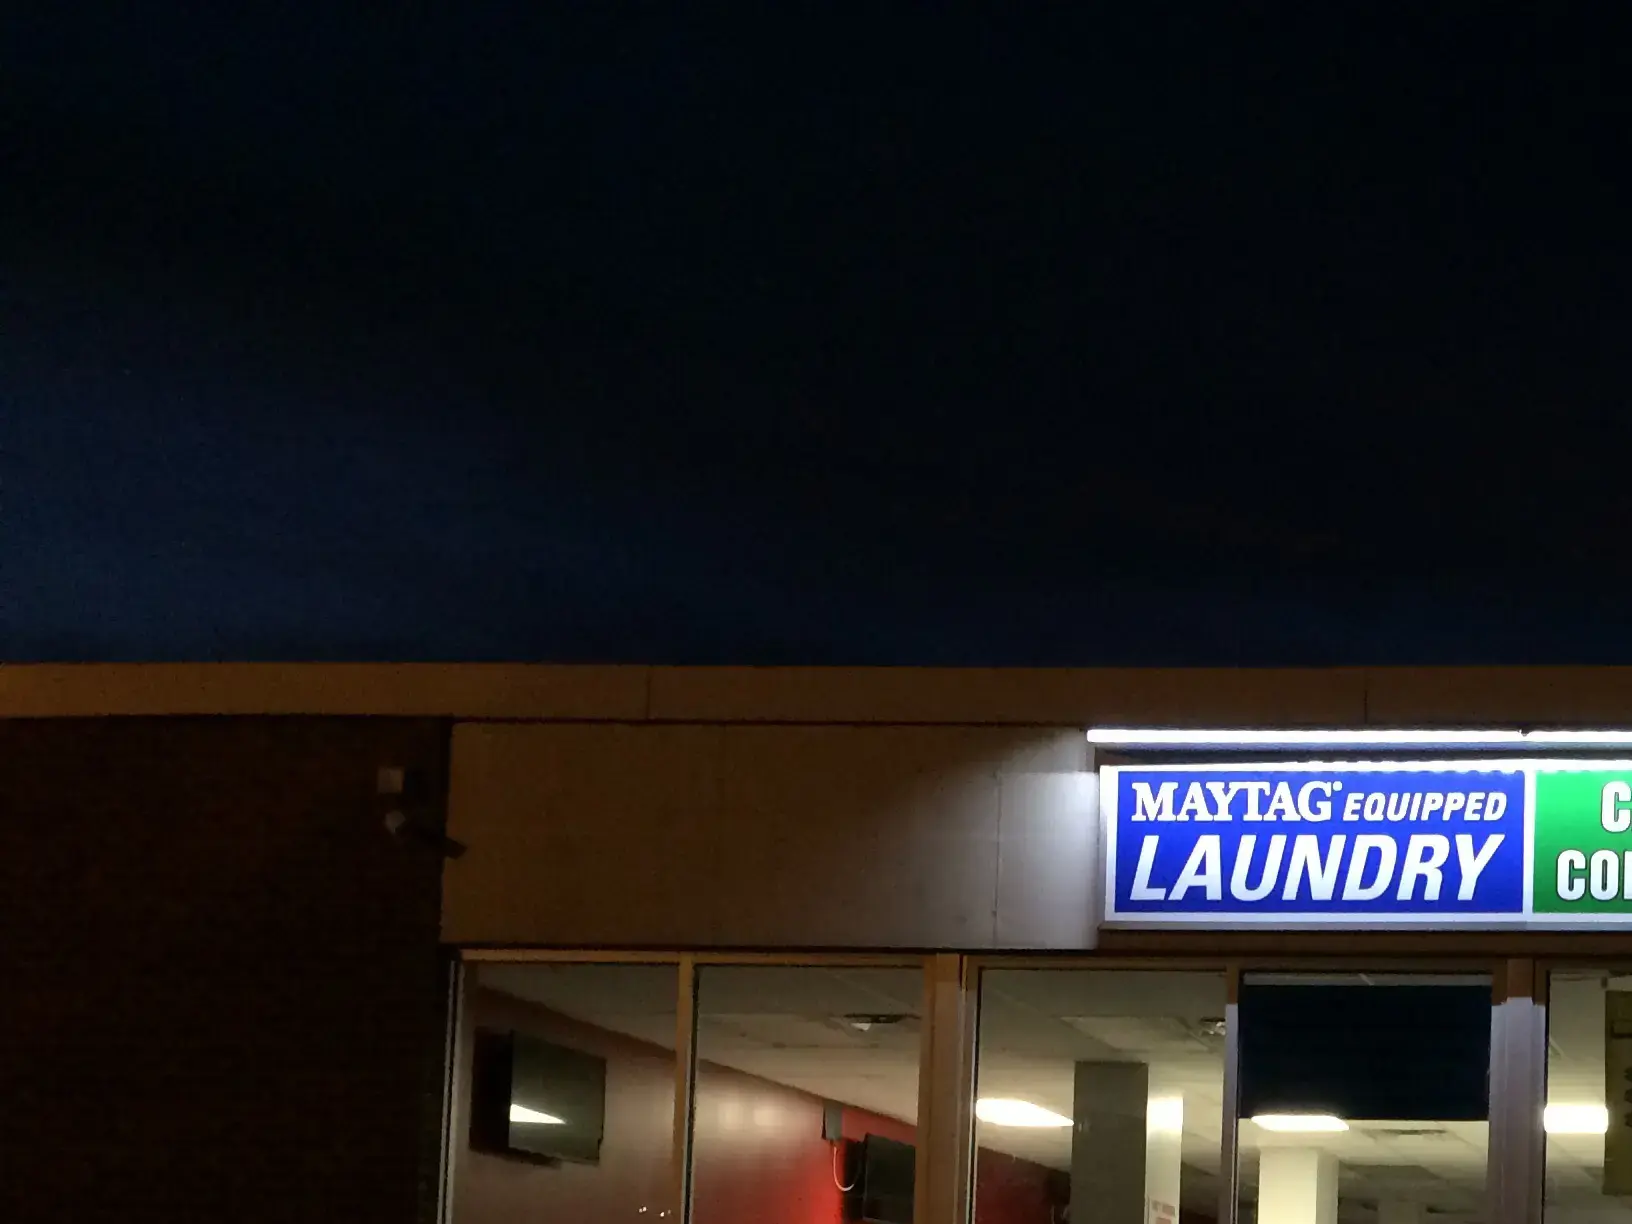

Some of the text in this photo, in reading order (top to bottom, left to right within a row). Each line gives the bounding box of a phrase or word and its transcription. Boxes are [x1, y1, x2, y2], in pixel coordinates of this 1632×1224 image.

[1131, 781, 1508, 822] MAYTAG EQUIPPED
[1129, 834, 1505, 902] LAUNDRY
